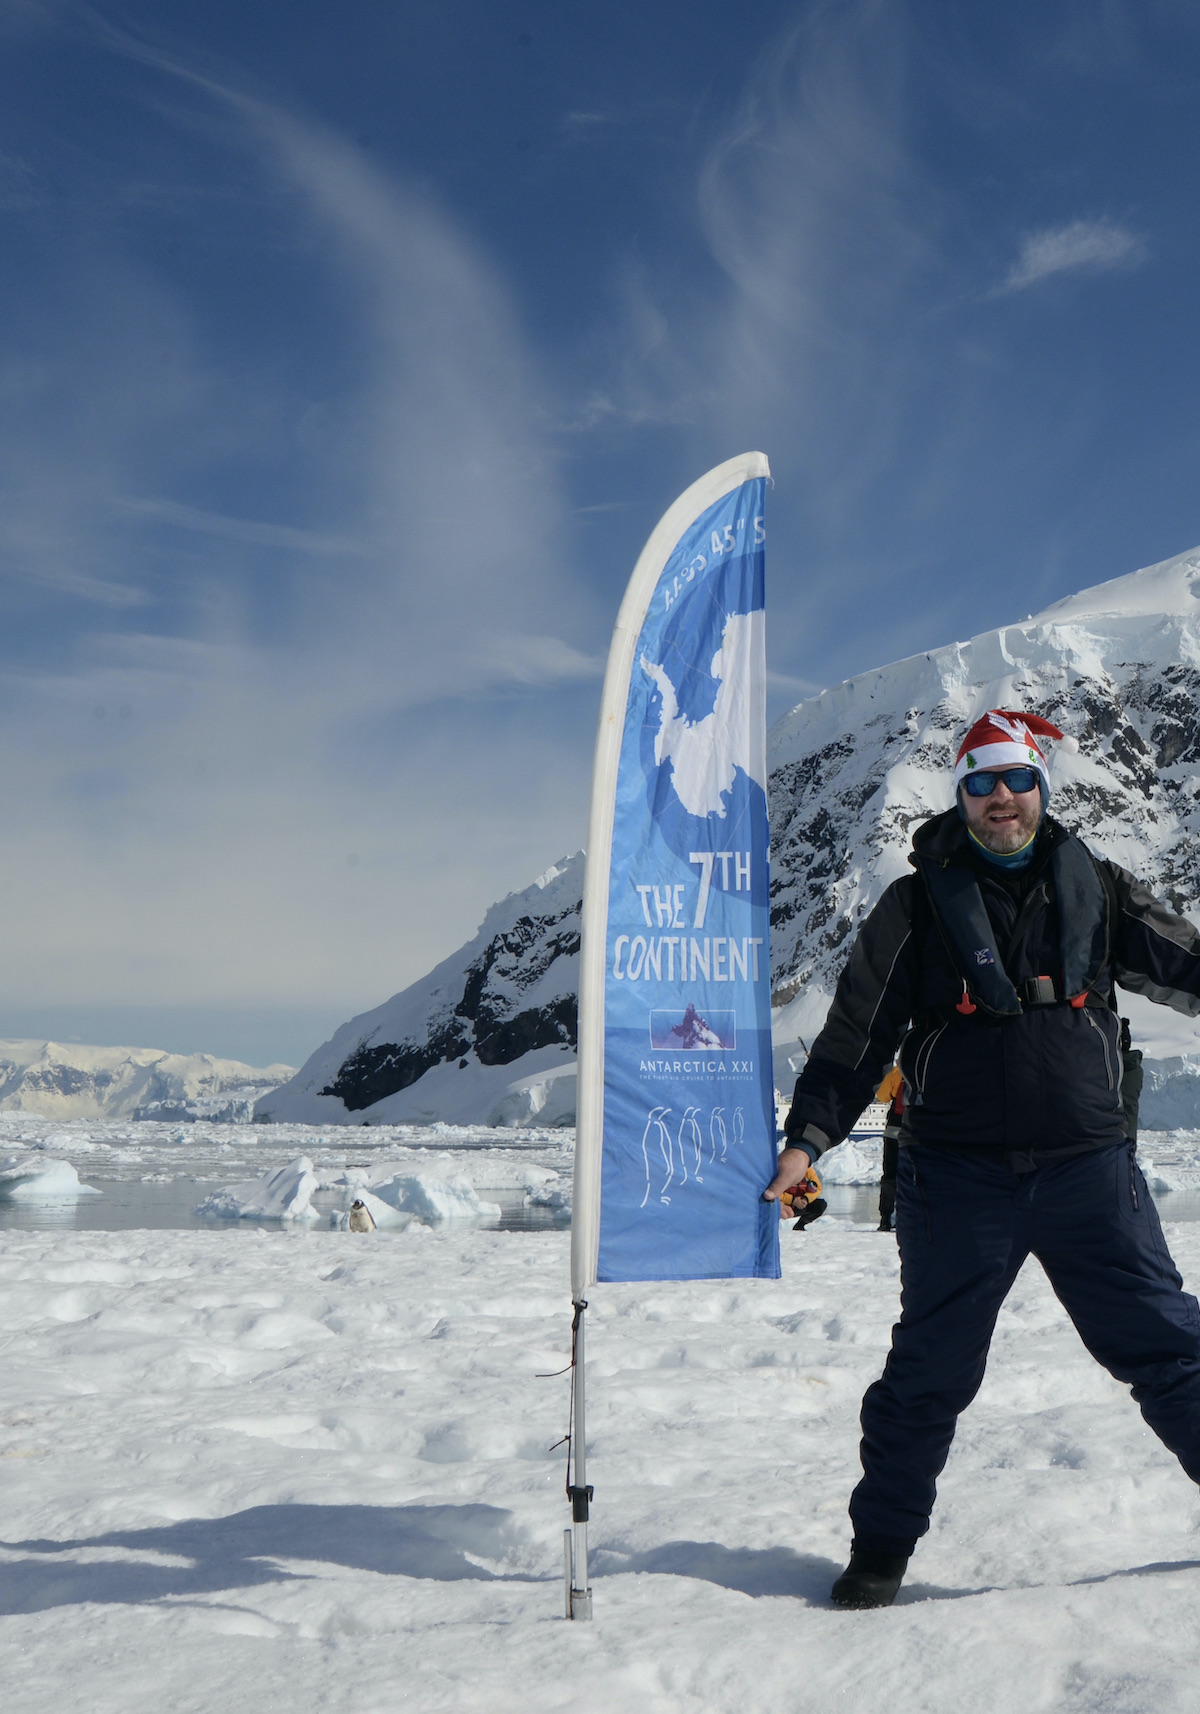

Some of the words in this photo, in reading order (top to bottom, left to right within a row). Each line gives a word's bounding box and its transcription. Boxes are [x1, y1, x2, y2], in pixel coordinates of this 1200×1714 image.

[636, 884, 685, 929] THE
[689, 851, 751, 929] 7TH
[613, 934, 764, 982] CONTINENT
[640, 1060, 727, 1073] ANTARCTICA
[732, 1060, 753, 1073] XXI
